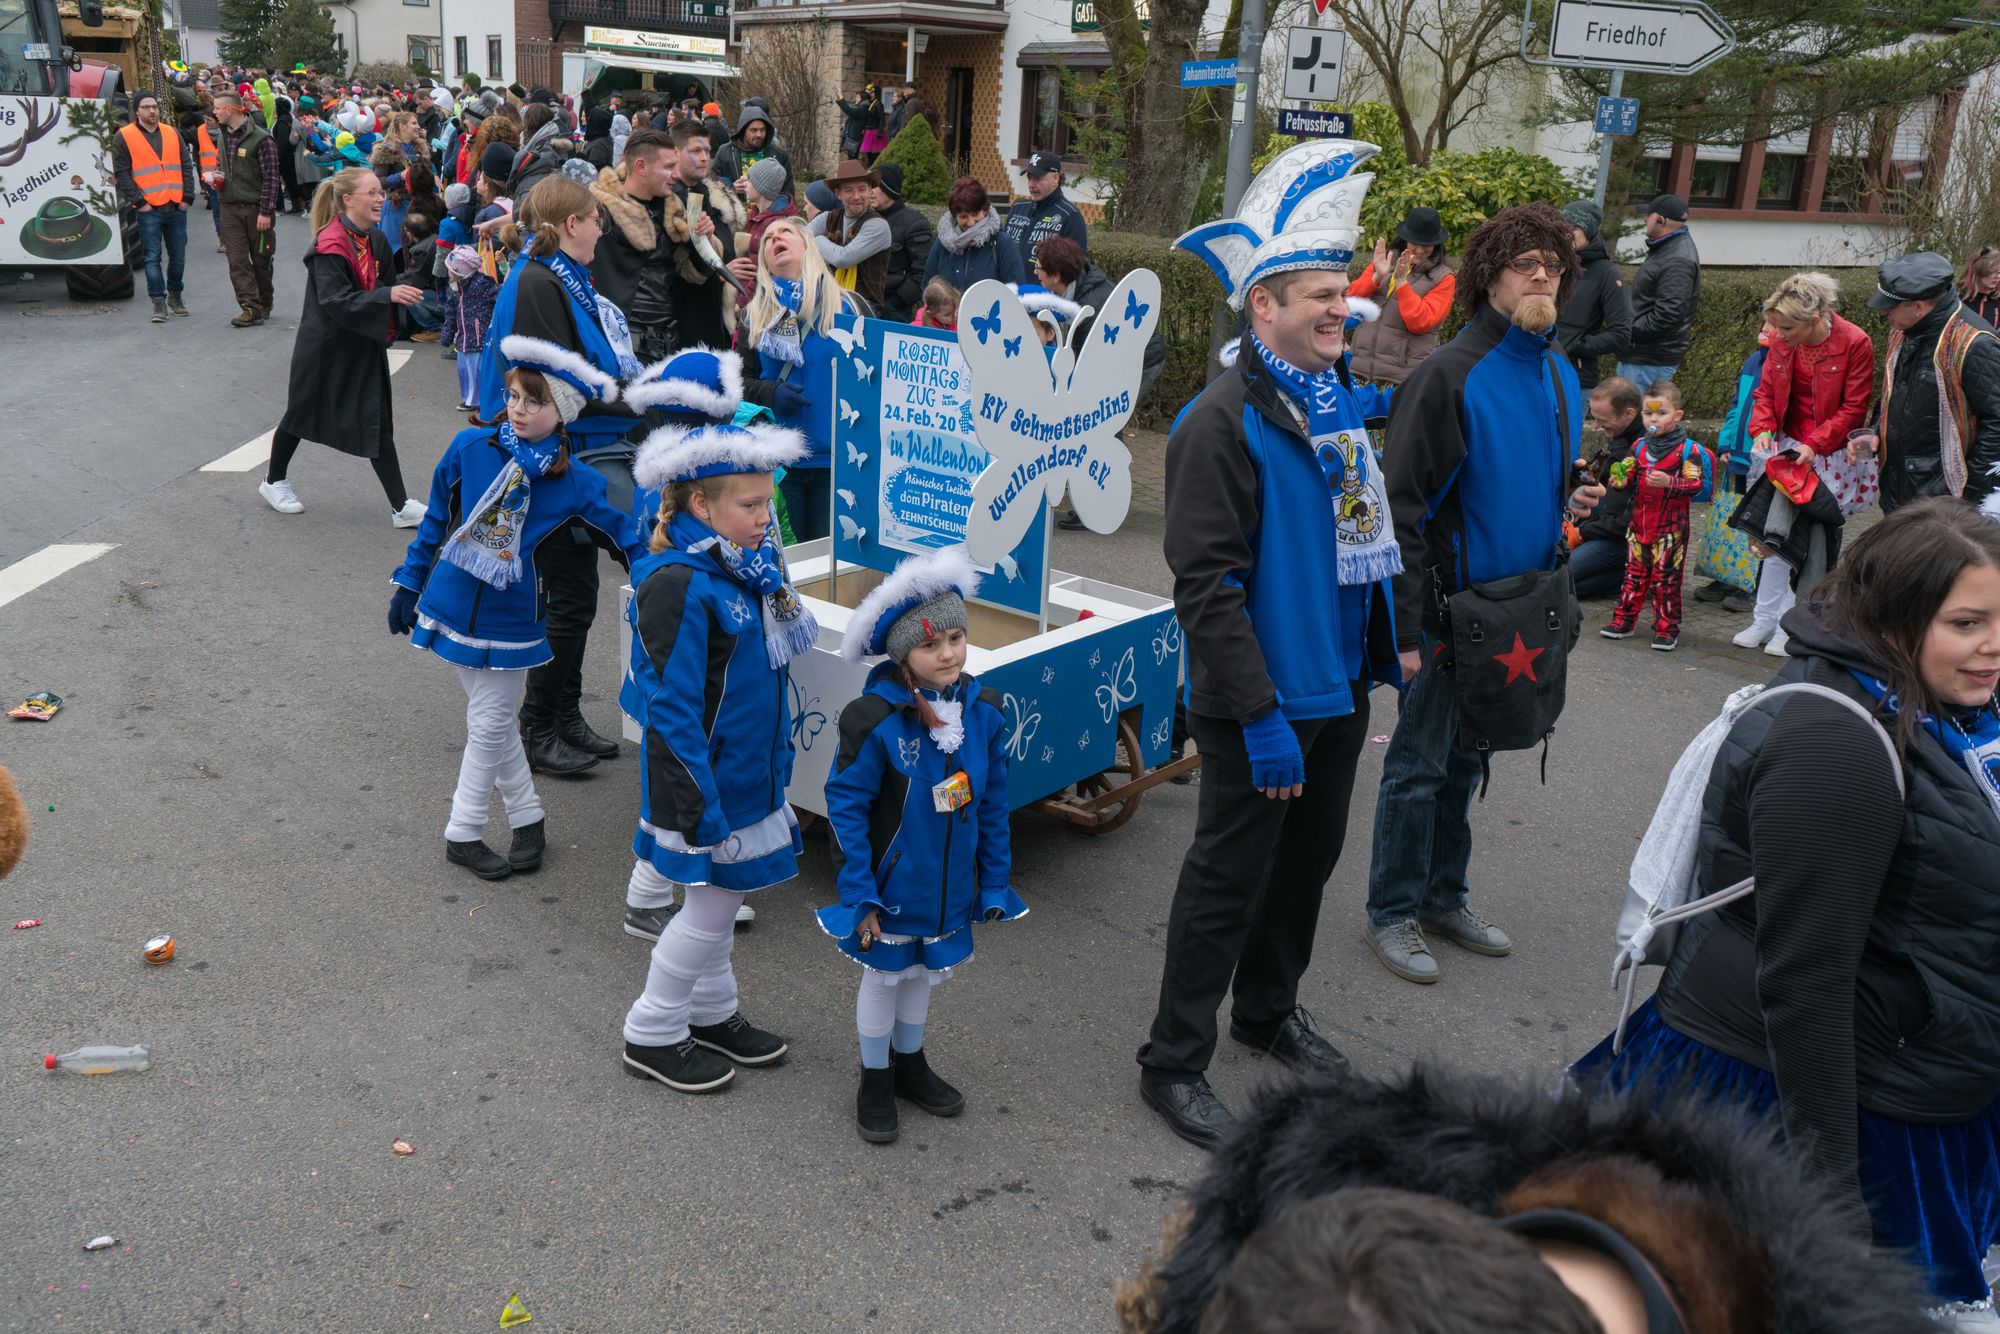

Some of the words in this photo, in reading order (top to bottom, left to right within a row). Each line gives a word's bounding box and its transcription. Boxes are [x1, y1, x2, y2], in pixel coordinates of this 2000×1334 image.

[633, 33, 680, 49] Sauerwein
[1585, 20, 1668, 49] Friedhof
[1284, 112, 1347, 135] Petrusstraße
[3, 159, 69, 208] Jagdhütte
[1034, 221, 1062, 231] DAVID
[898, 340, 950, 367] ROSEN
[886, 359, 960, 390] MONTAGS
[906, 384, 936, 408] ZUG
[1312, 380, 1337, 415] KV
[884, 404, 905, 422] 24.
[906, 408, 934, 428] Feb.
[935, 412, 956, 432] '20
[979, 392, 1008, 425] KV
[1010, 390, 1131, 443] Schmetterling
[890, 430, 904, 458] in
[988, 443, 1088, 522] Wallendorf
[1088, 458, 1111, 491] e.V.
[900, 490, 921, 506] dom
[921, 492, 969, 517] Piraten
[900, 510, 967, 535] ZEHNTSCHEUNE
[473, 528, 515, 547] WALNDORF
